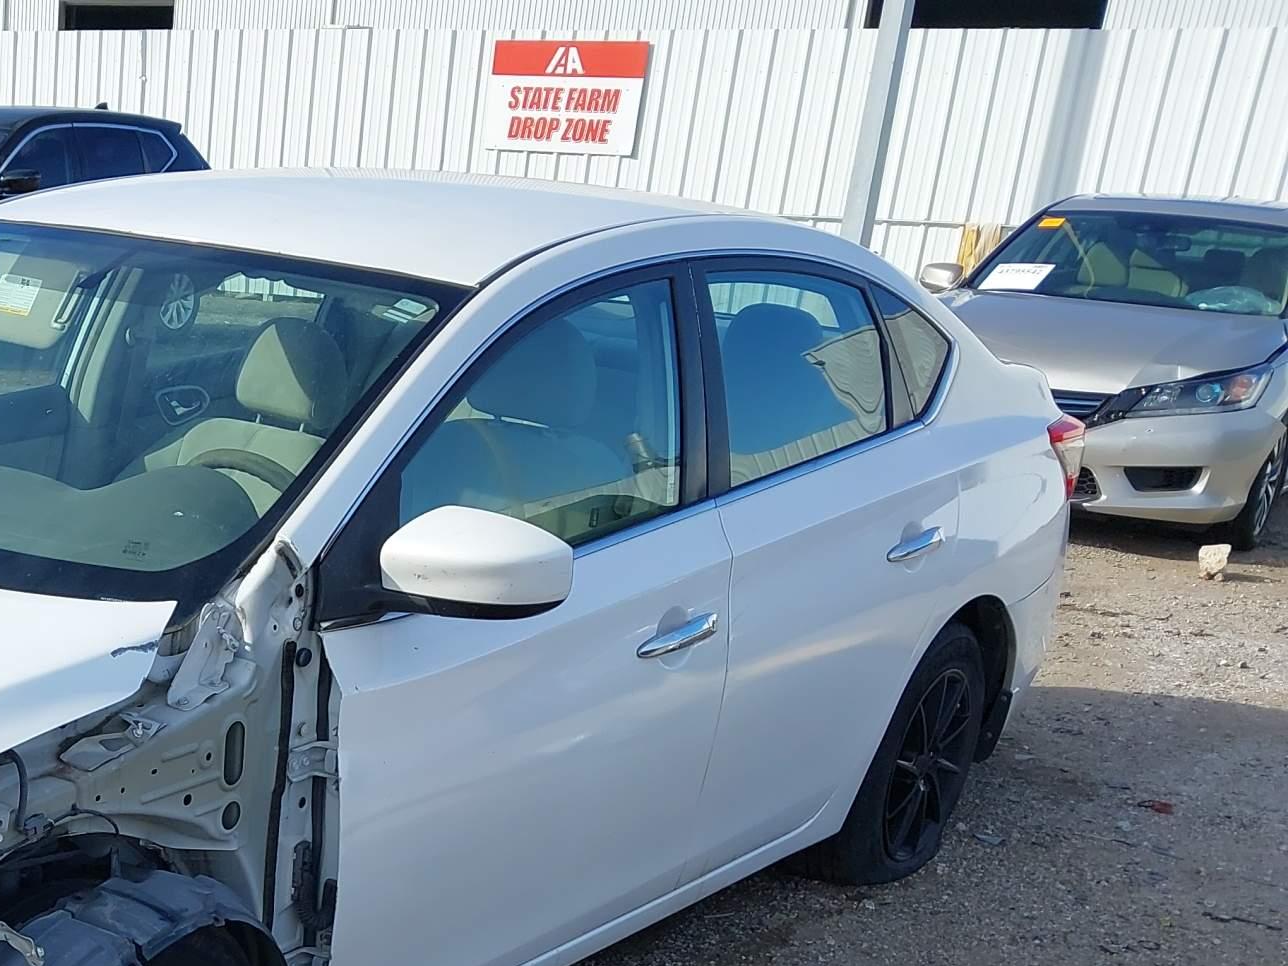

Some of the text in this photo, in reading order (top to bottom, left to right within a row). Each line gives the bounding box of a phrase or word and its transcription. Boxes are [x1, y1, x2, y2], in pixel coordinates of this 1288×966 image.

[508, 86, 622, 114] STATE FARM
[507, 116, 612, 144] DROP ZONE
